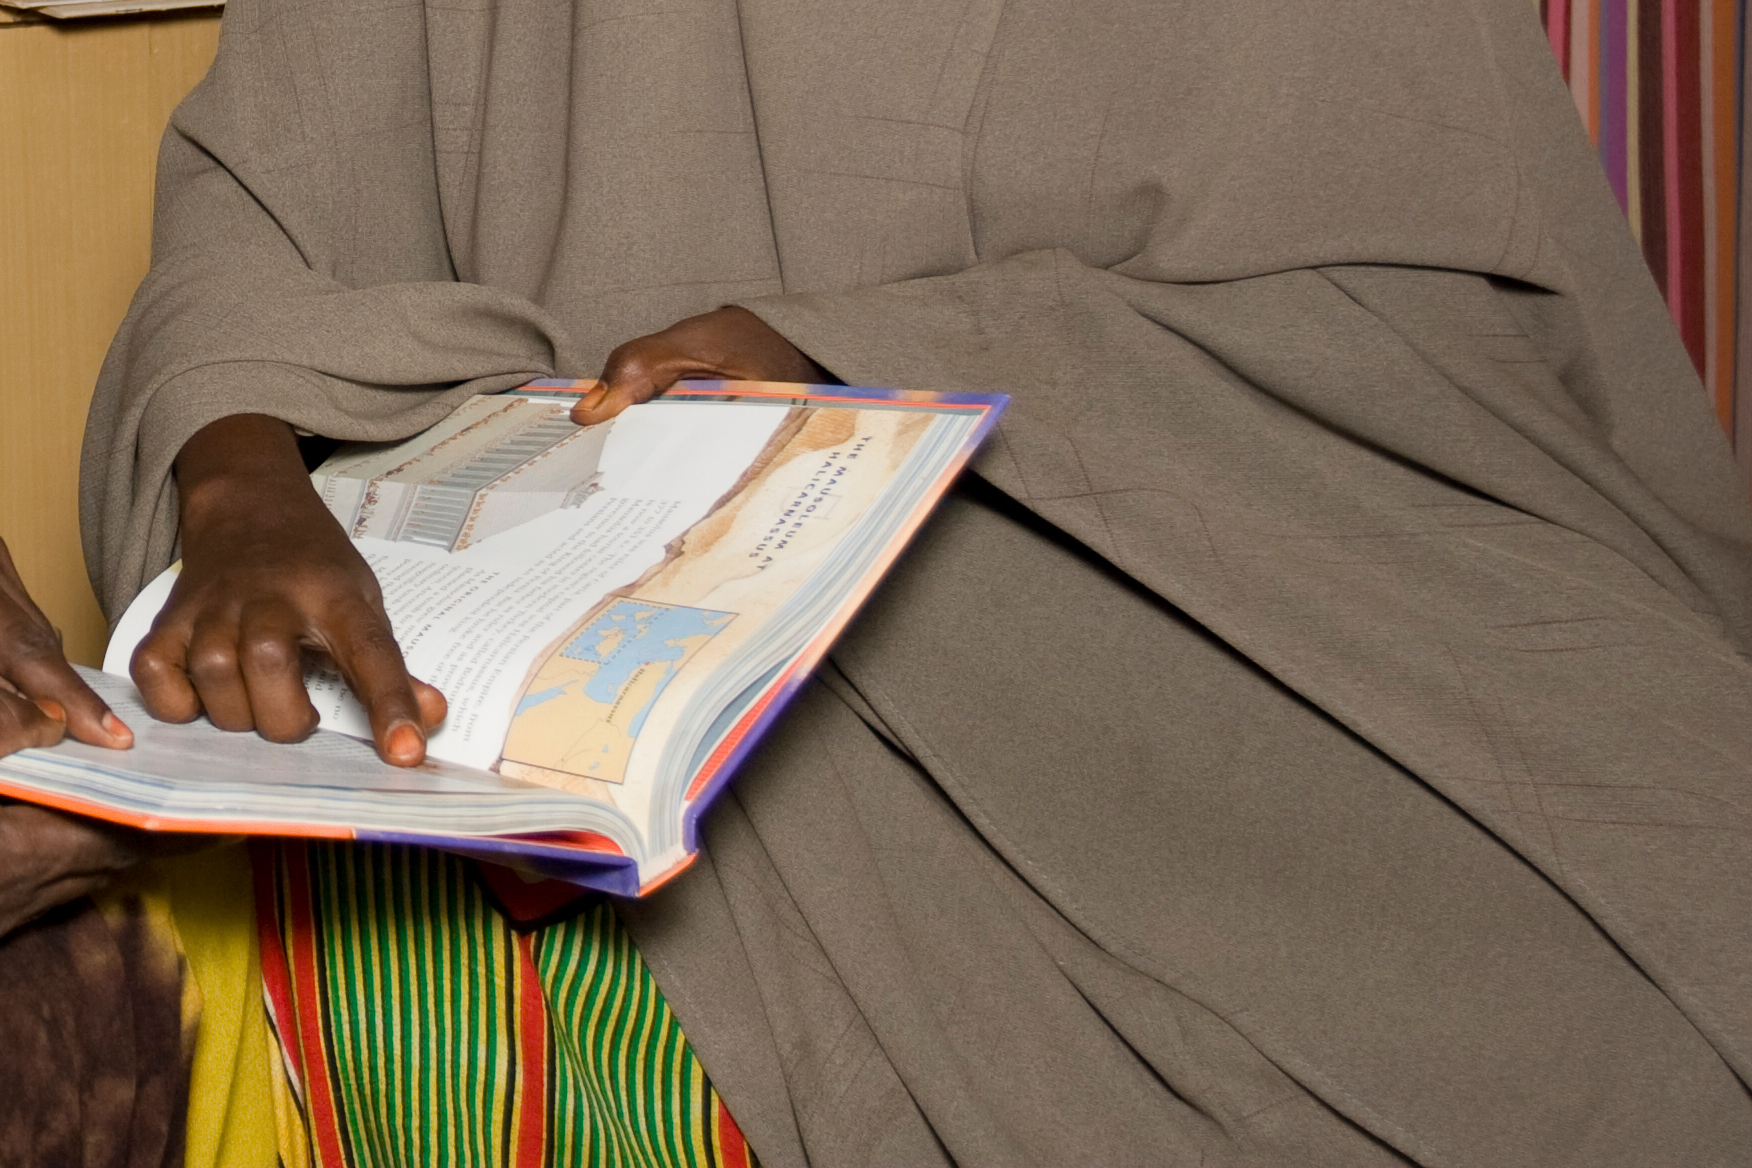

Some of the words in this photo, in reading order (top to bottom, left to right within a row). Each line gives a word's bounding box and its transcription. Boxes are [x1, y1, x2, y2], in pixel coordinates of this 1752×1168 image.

[846, 433, 872, 462] THE
[747, 448, 841, 561] HALICARNASSUS
[773, 464, 846, 552] MAUSOLEUM
[597, 550, 616, 568] The
[756, 554, 773, 571] AT
[480, 569, 499, 586] THE
[432, 583, 478, 622] ORIGINAL
[525, 581, 559, 611] modern
[482, 612, 503, 634] ruler
[519, 612, 536, 629] was
[527, 619, 544, 635] the
[465, 631, 483, 651] and
[468, 635, 495, 665] called
[498, 632, 530, 667] Persian
[456, 650, 467, 662] as
[470, 666, 503, 710] Empire,
[331, 704, 342, 720] no
[449, 695, 472, 734] which
[460, 712, 479, 742] from
